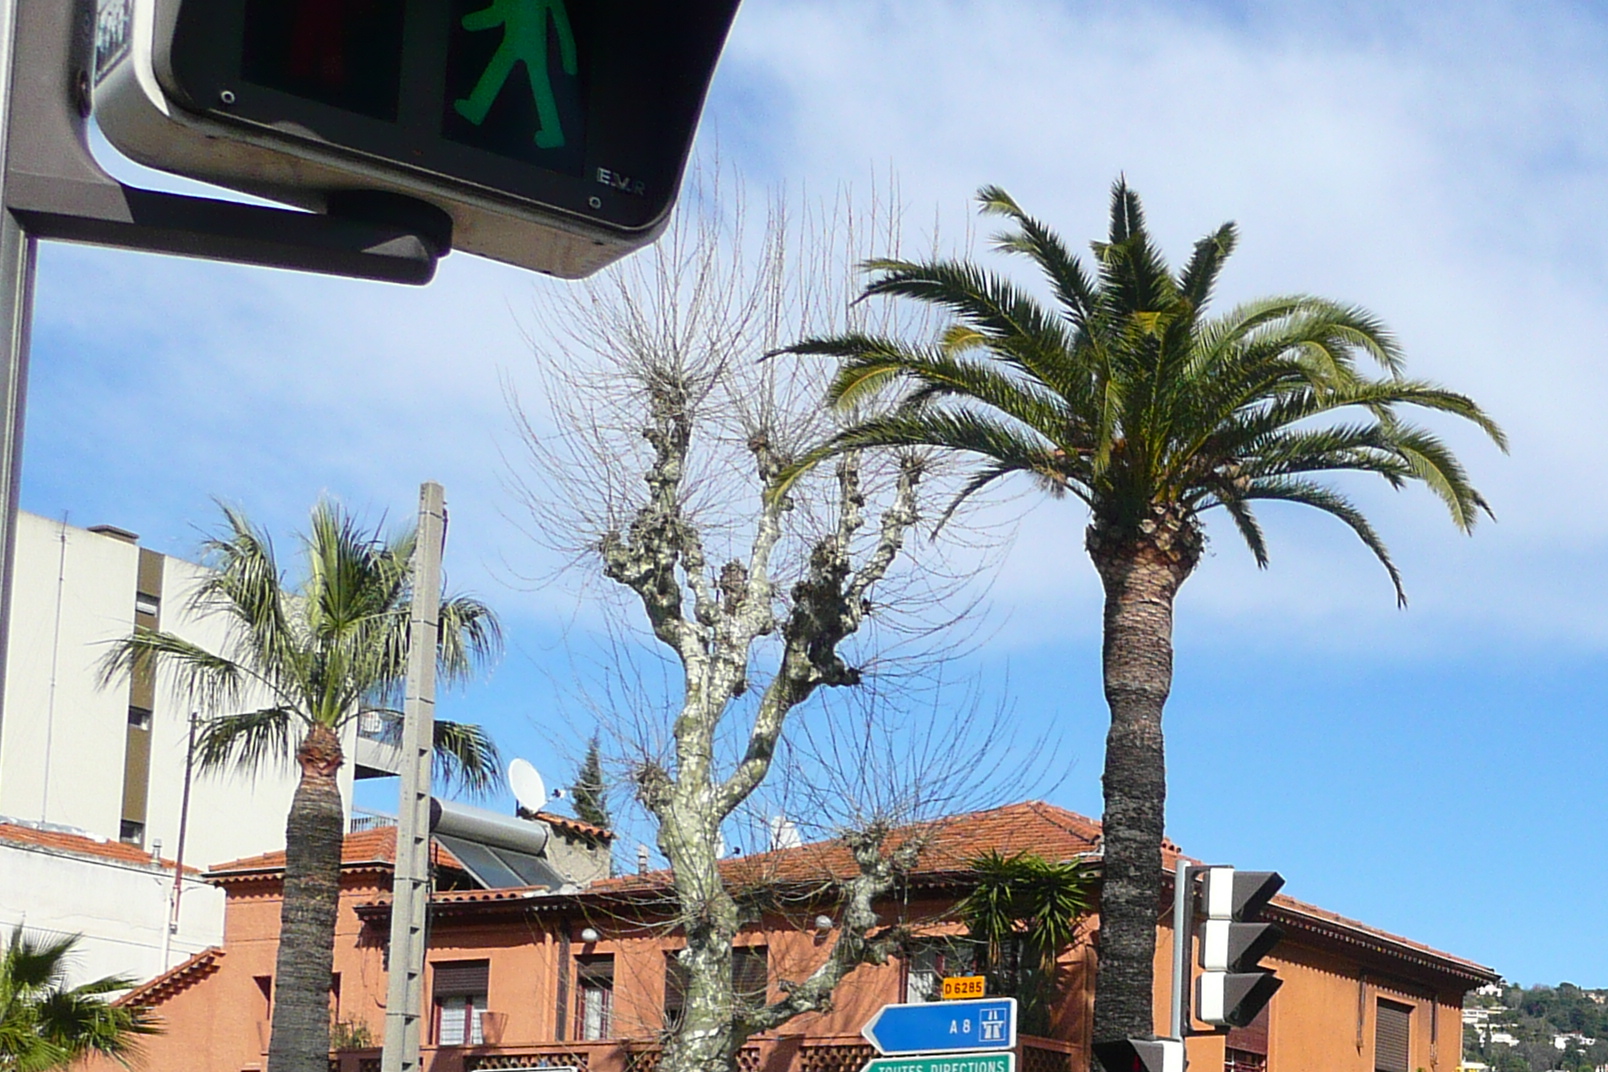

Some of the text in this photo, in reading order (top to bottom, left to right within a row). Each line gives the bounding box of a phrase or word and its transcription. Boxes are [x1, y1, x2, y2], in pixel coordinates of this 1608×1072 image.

[945, 981, 982, 994] D 6285
[949, 1018, 971, 1034] A 8
